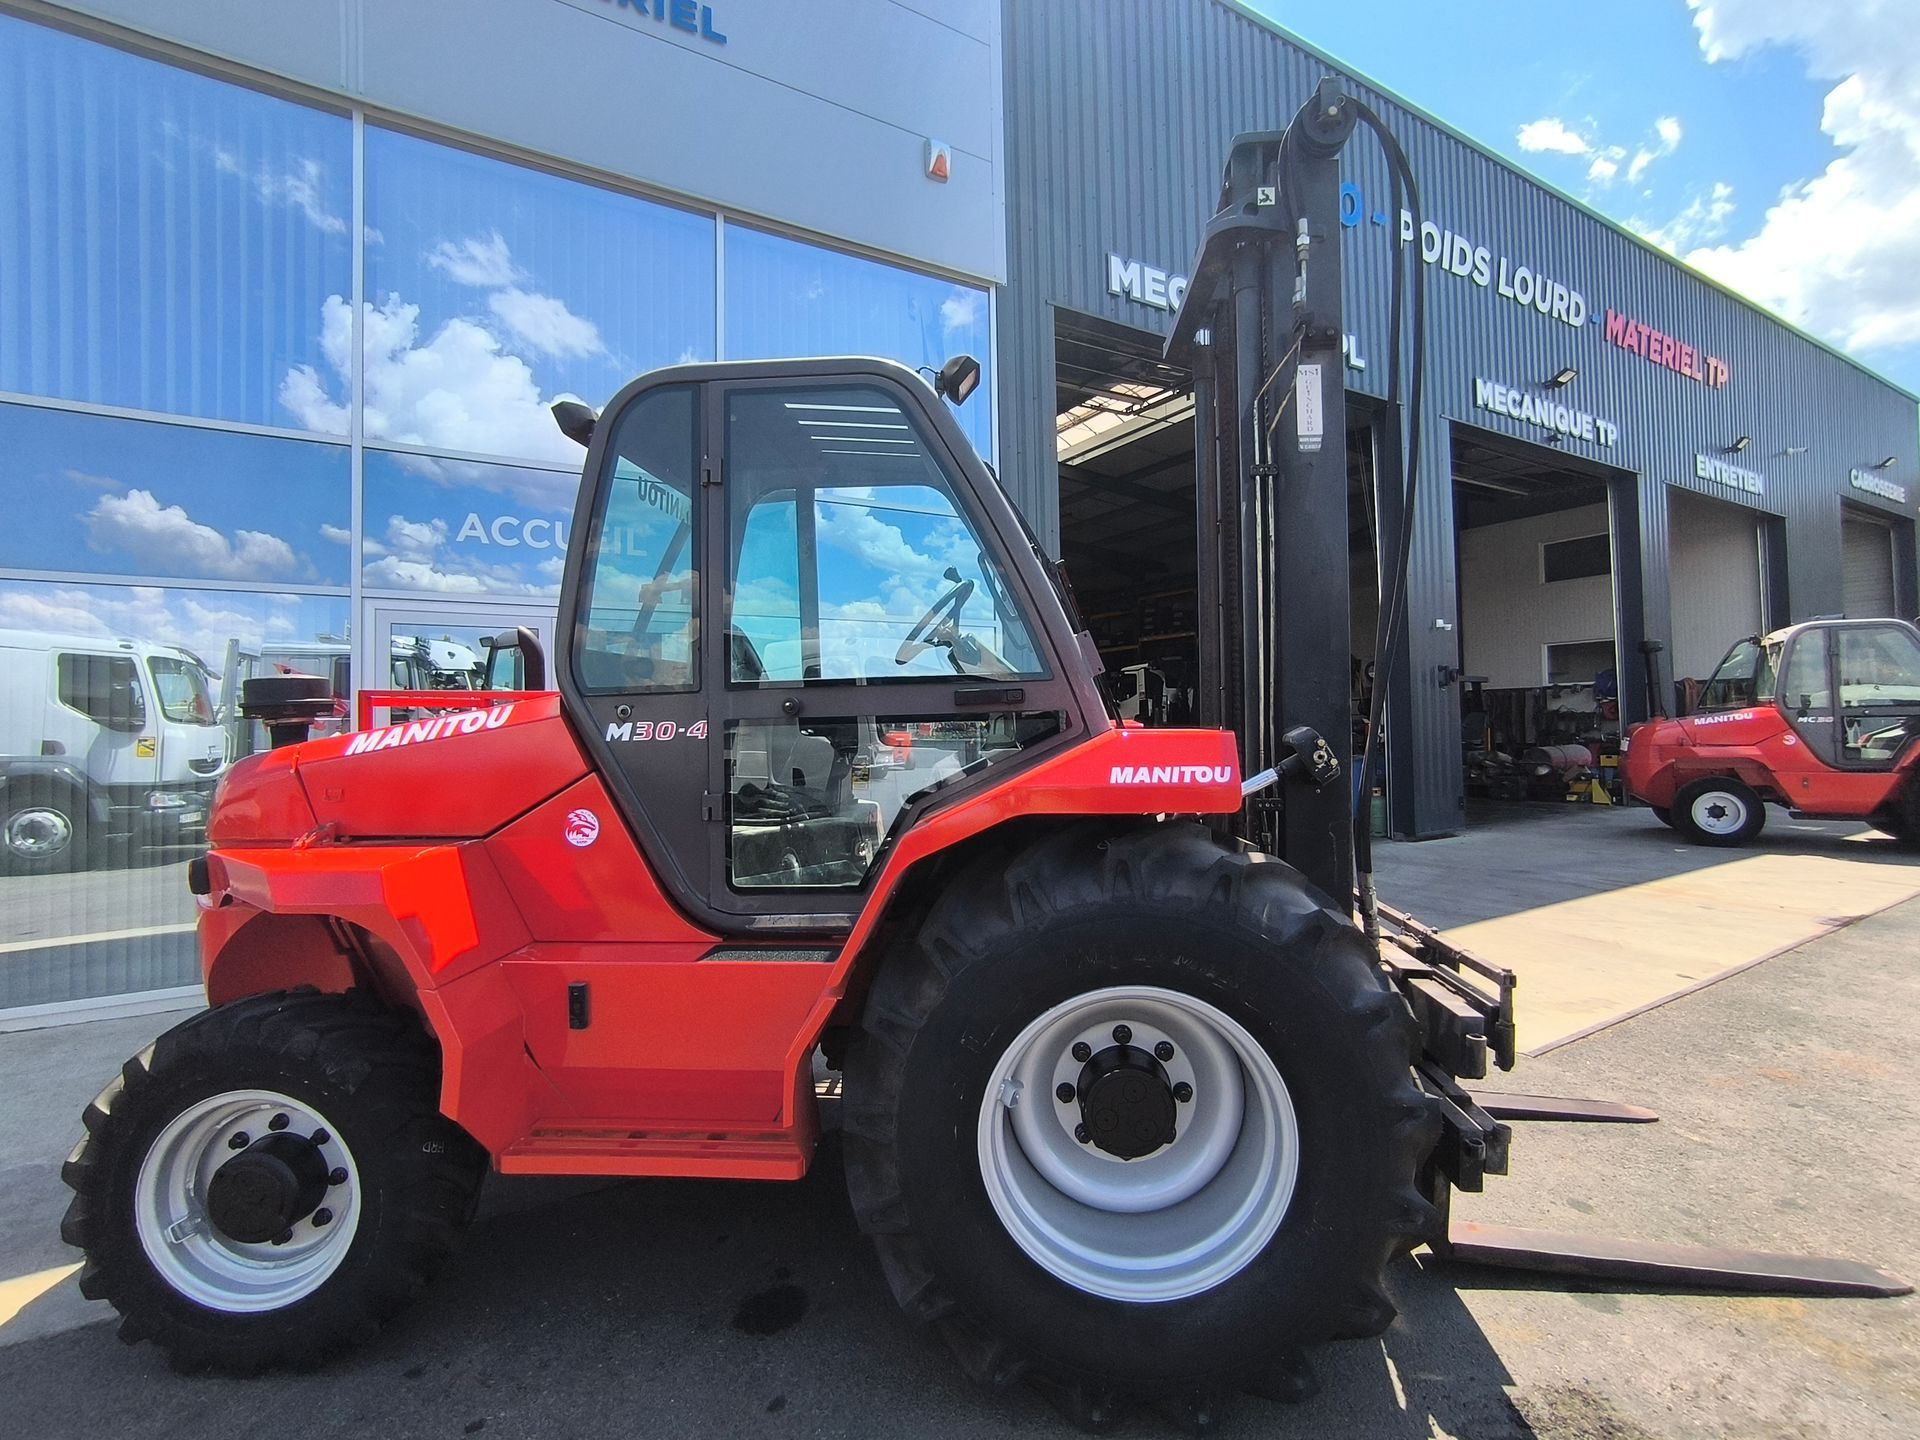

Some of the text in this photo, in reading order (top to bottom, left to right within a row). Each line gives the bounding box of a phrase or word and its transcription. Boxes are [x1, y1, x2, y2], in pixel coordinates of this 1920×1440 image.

[1400, 208, 1492, 287] POIDS
[1498, 256, 1586, 328] LOURD
[1605, 307, 1702, 383] MATERIEL
[1704, 354, 1729, 390] TP
[1475, 376, 1619, 448] MECANIQUE TP
[1695, 453, 1763, 497] ENTRETIEN
[344, 704, 516, 757] MANITOU
[605, 720, 708, 742] M30-4
[1694, 711, 1753, 726] MANITOU
[1109, 765, 1232, 785] MANITOU
